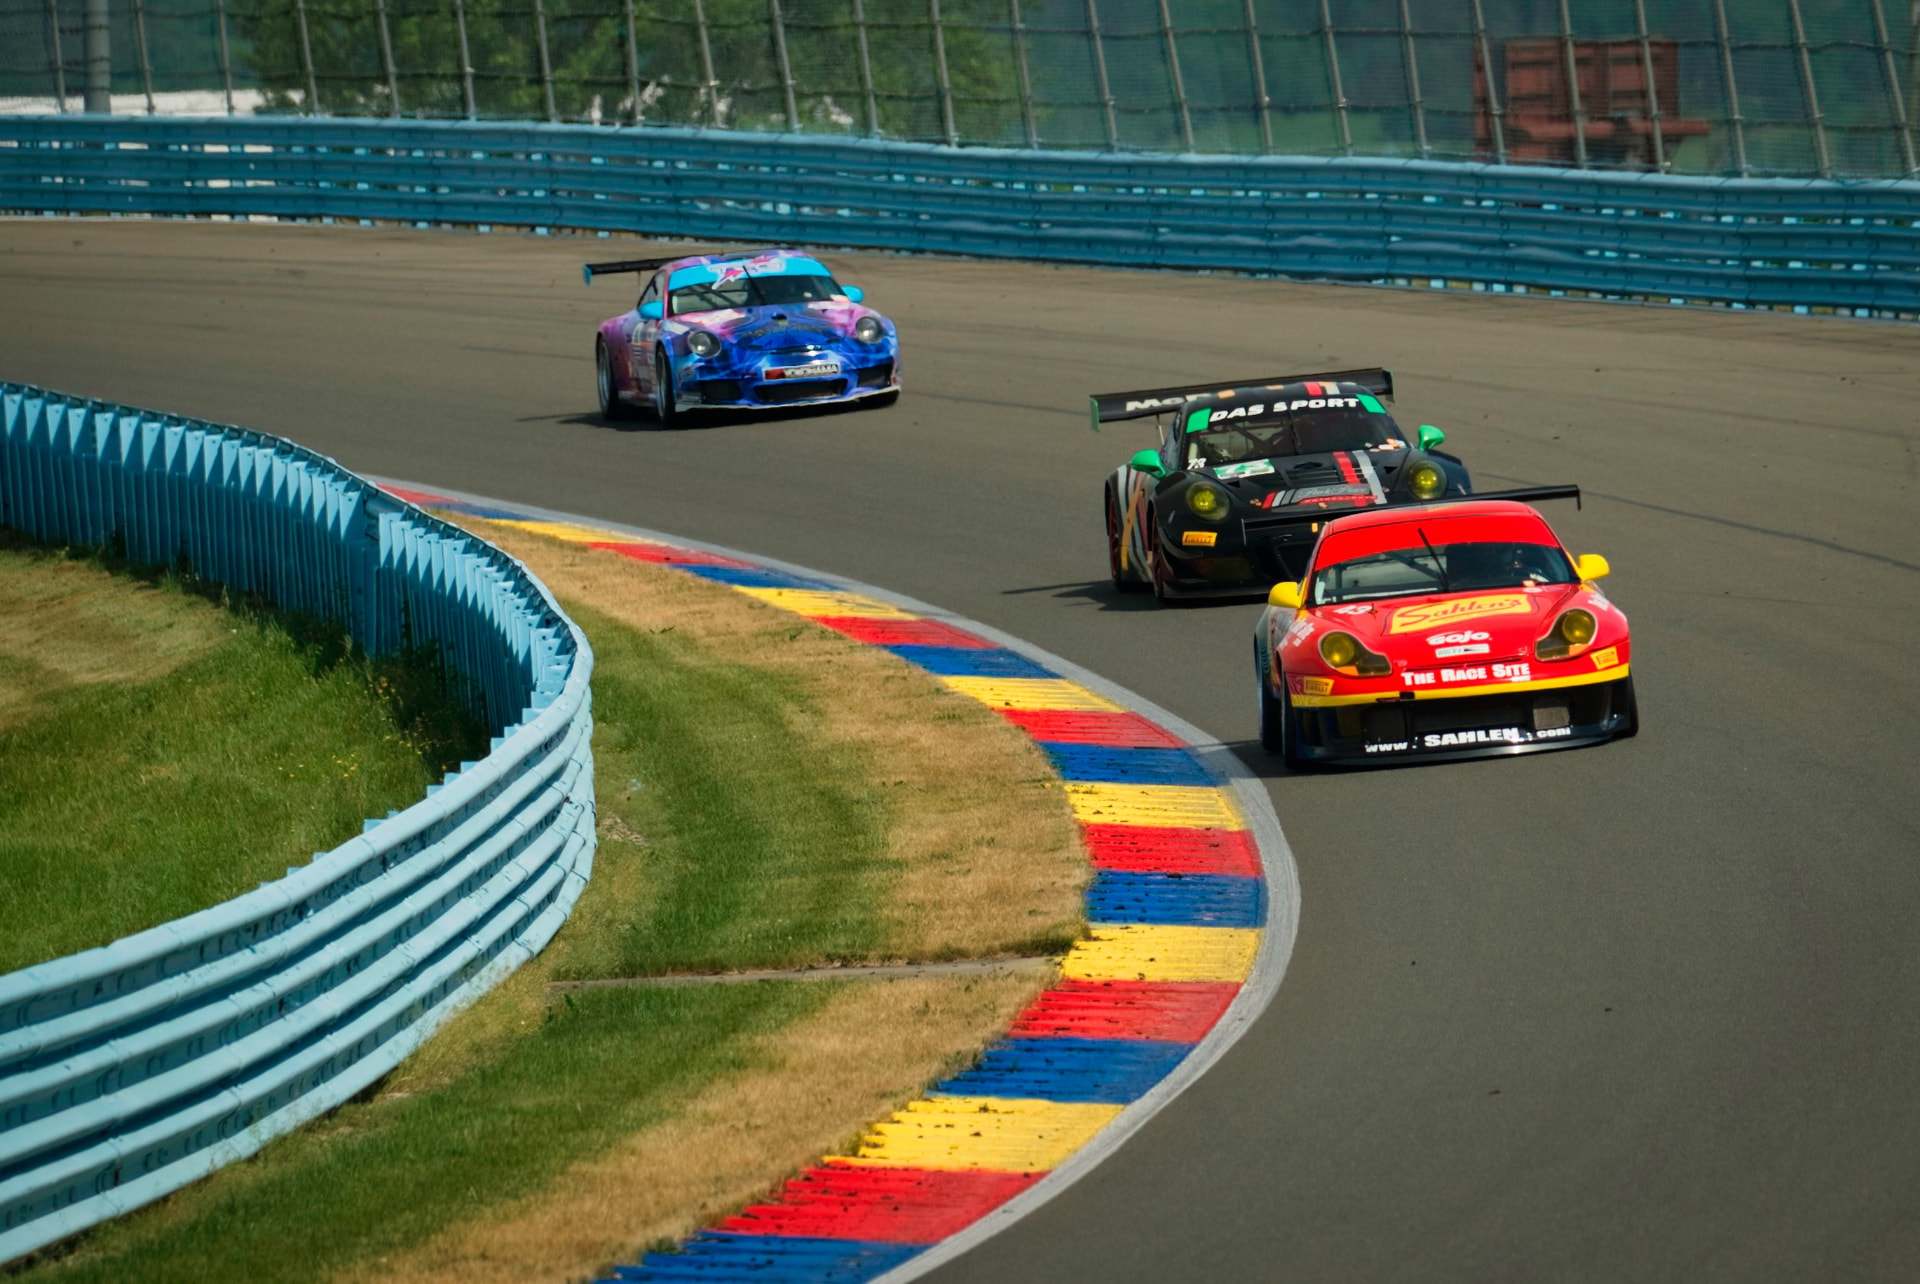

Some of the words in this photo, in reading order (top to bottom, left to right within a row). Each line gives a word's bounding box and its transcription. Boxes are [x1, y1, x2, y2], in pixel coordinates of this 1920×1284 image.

[1209, 404, 1264, 422] DAS
[1273, 398, 1358, 413] SPORT
[1333, 605, 1371, 615] 43
[1396, 599, 1522, 627] Sahlen's
[1400, 672, 1436, 686] THE
[1440, 667, 1488, 683] RACE
